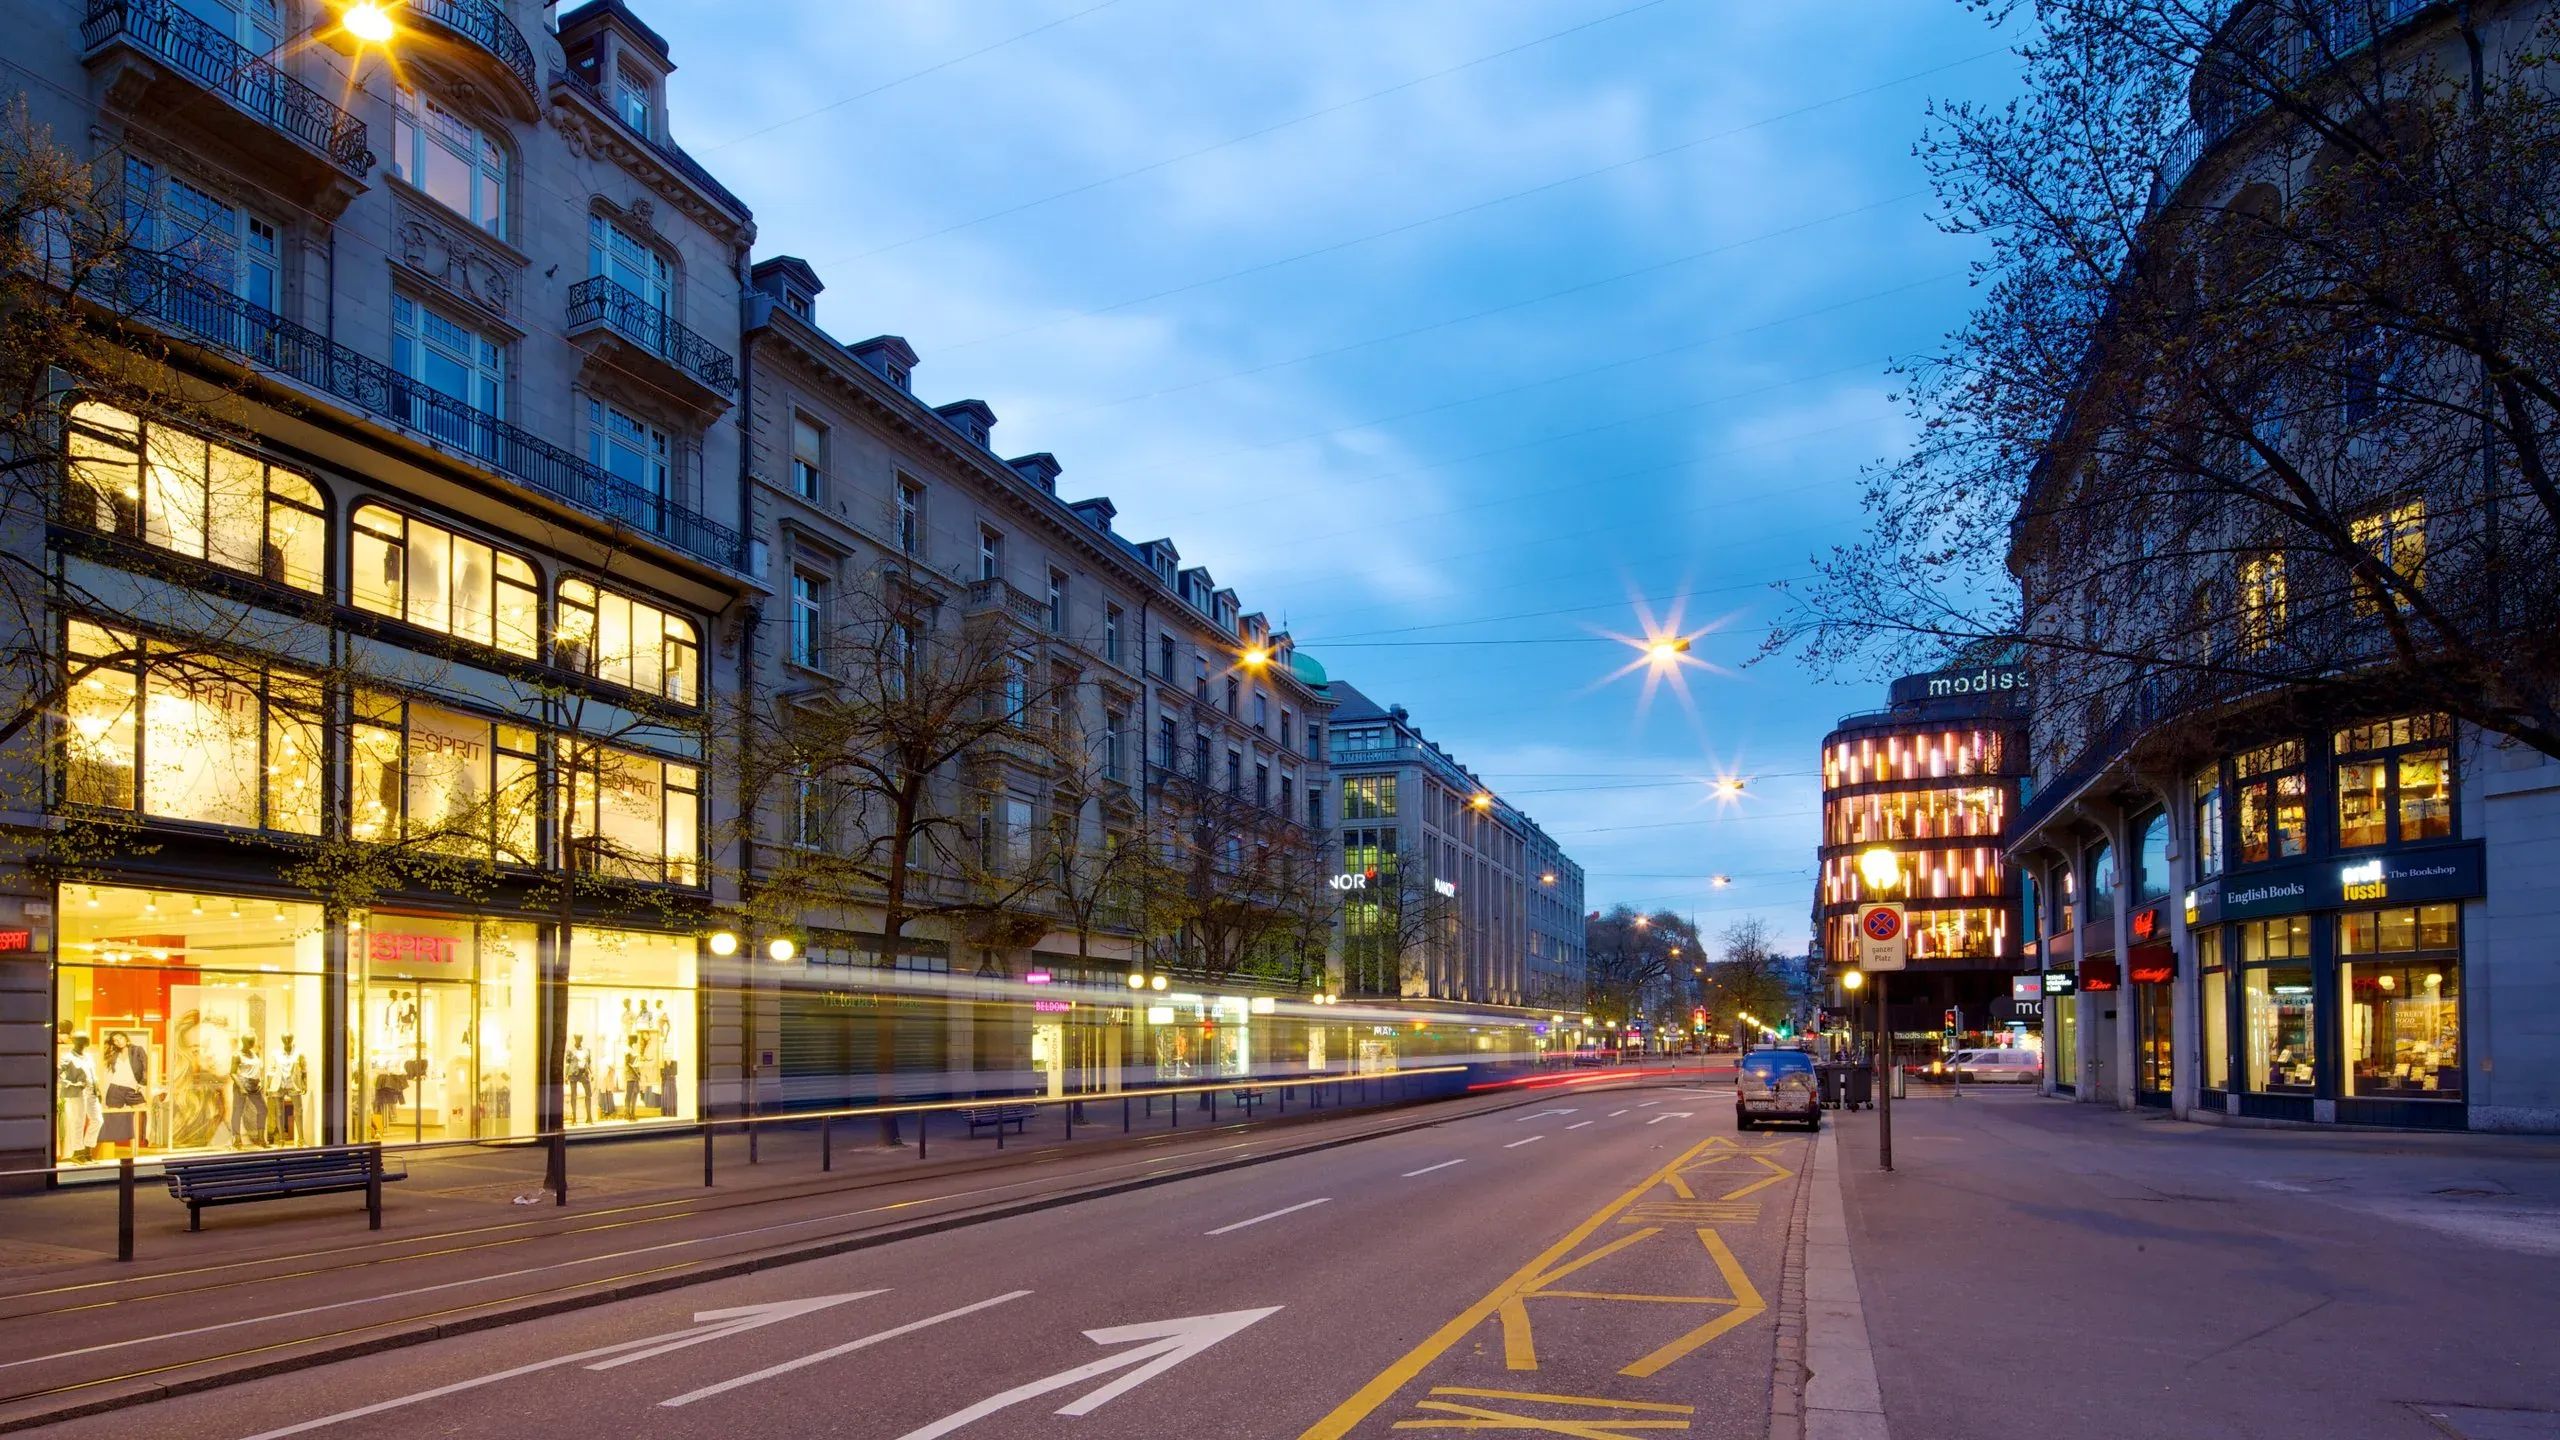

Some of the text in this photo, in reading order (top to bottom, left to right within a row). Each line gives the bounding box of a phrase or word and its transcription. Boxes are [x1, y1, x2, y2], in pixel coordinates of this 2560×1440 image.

[410, 728, 485, 761] ESPRIT
[2389, 865, 2456, 879] The Bookshop
[2227, 887, 2268, 904] English
[2269, 882, 2305, 898] Books
[1872, 946, 1894, 954] ganzer
[1874, 954, 1892, 962] Platz
[1034, 1000, 1070, 1012] BELDONA
